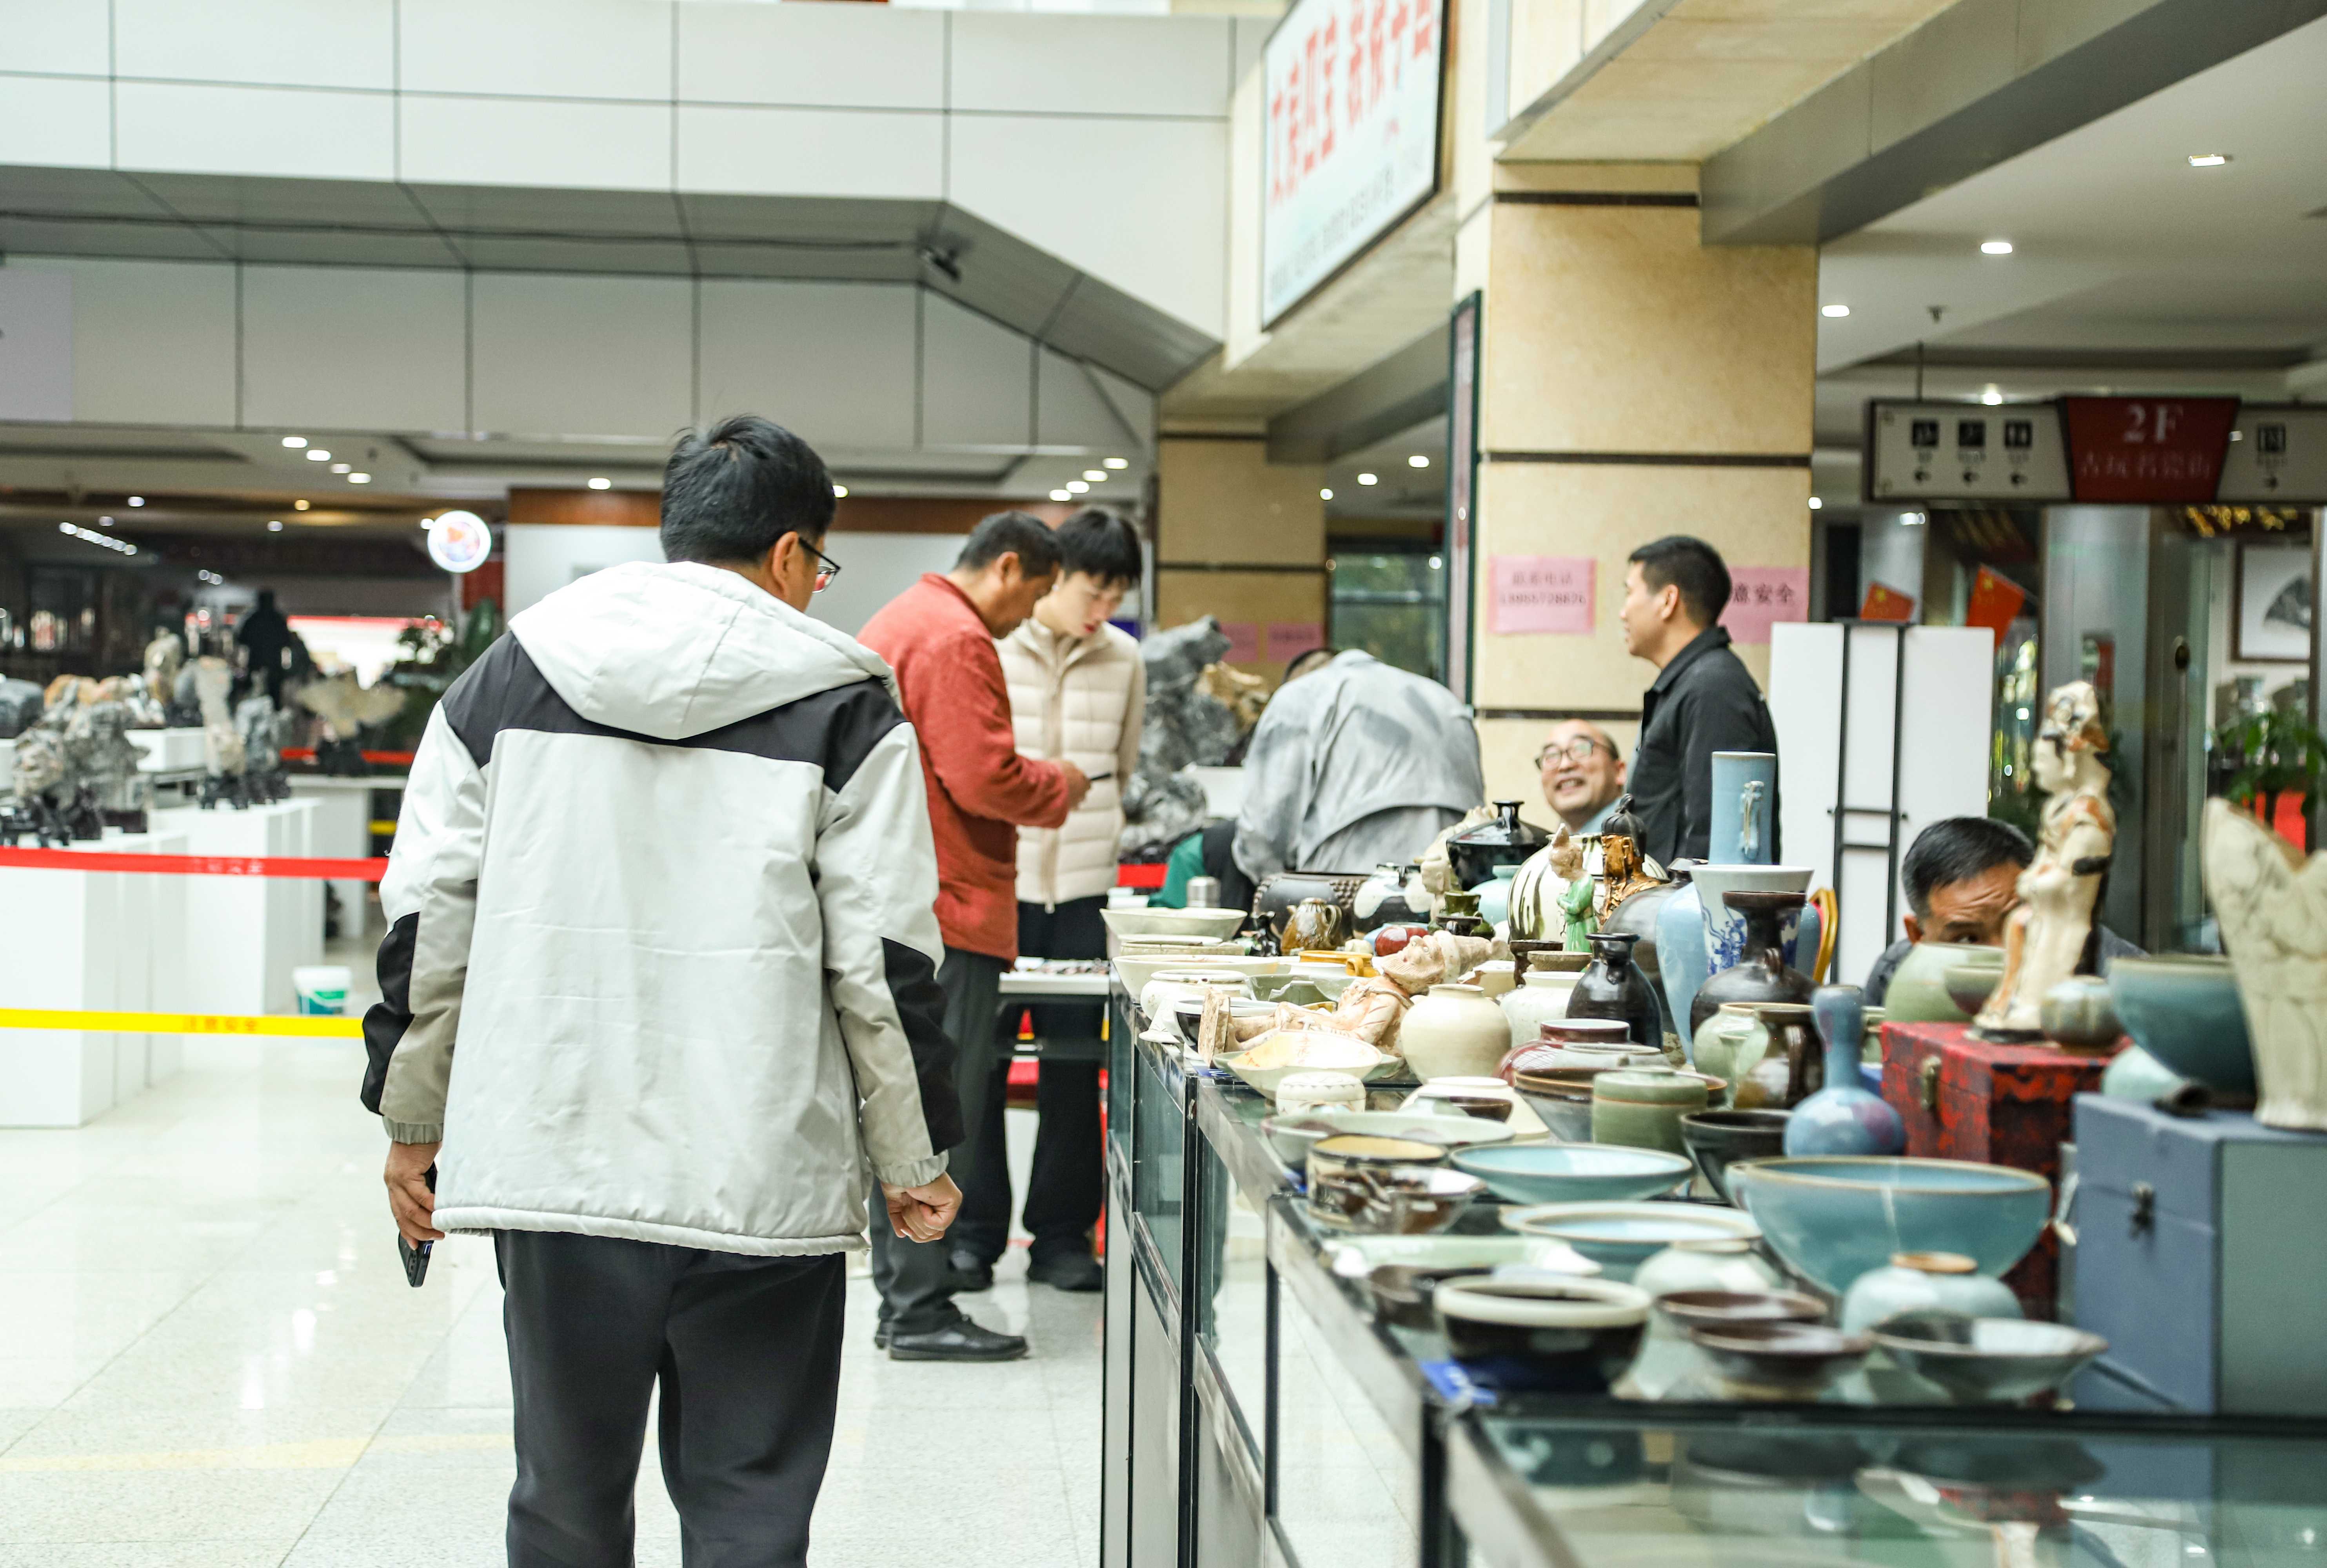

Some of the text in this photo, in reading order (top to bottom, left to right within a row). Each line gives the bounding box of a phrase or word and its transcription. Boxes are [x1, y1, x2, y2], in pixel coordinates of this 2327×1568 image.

[2123, 404, 2183, 443] 2F
[1511, 571, 1573, 586] 联系电话
[182, 1016, 259, 1033] 注意安全
